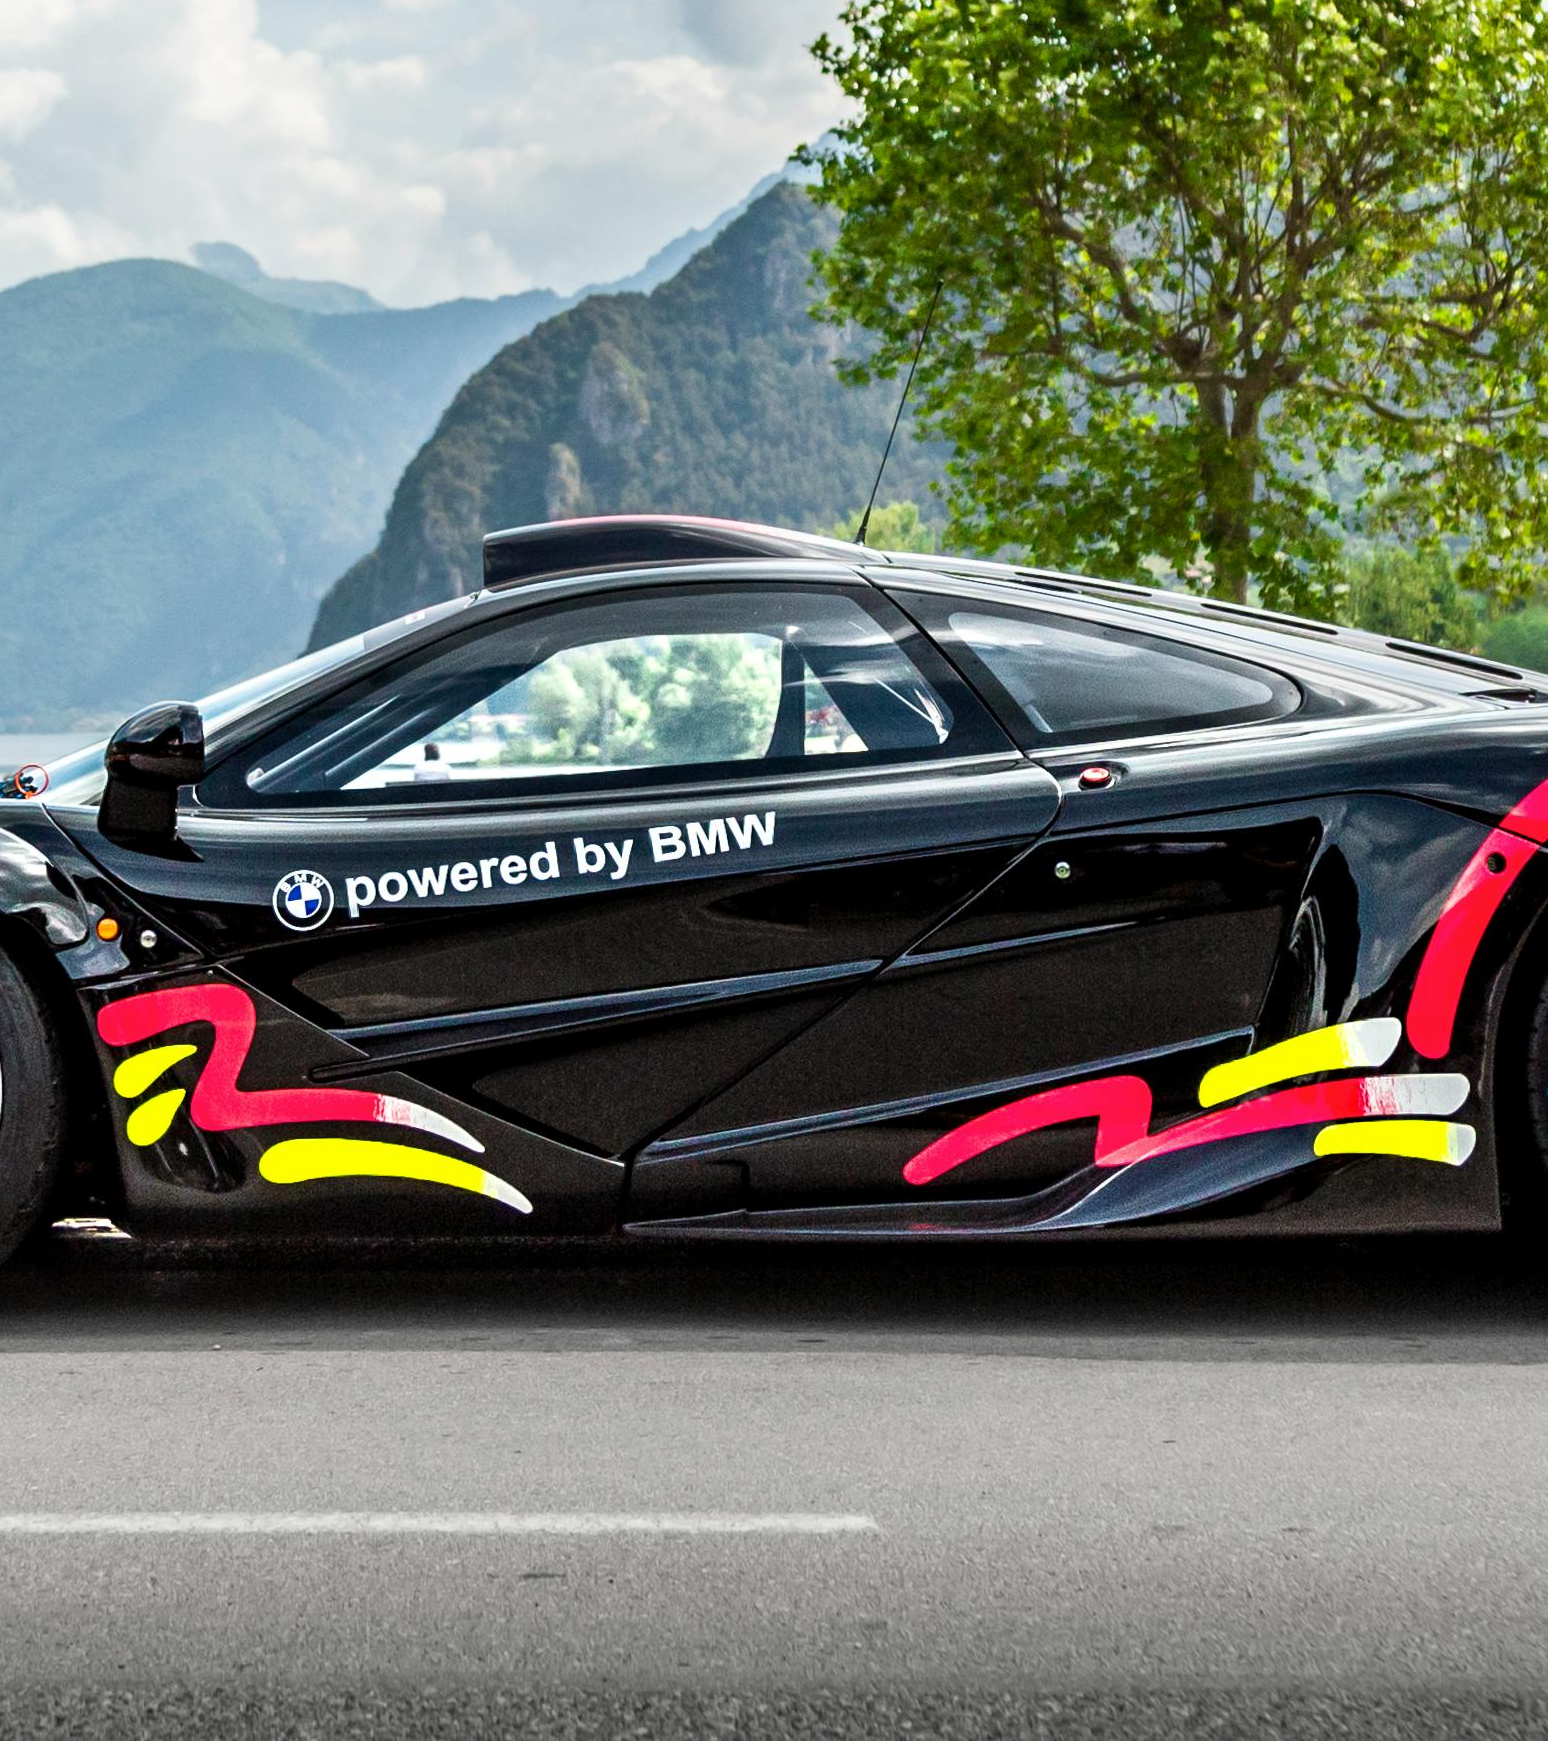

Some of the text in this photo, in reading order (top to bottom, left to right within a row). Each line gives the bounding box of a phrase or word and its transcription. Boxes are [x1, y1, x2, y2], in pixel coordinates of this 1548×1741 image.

[345, 810, 776, 918] powered by BMW
